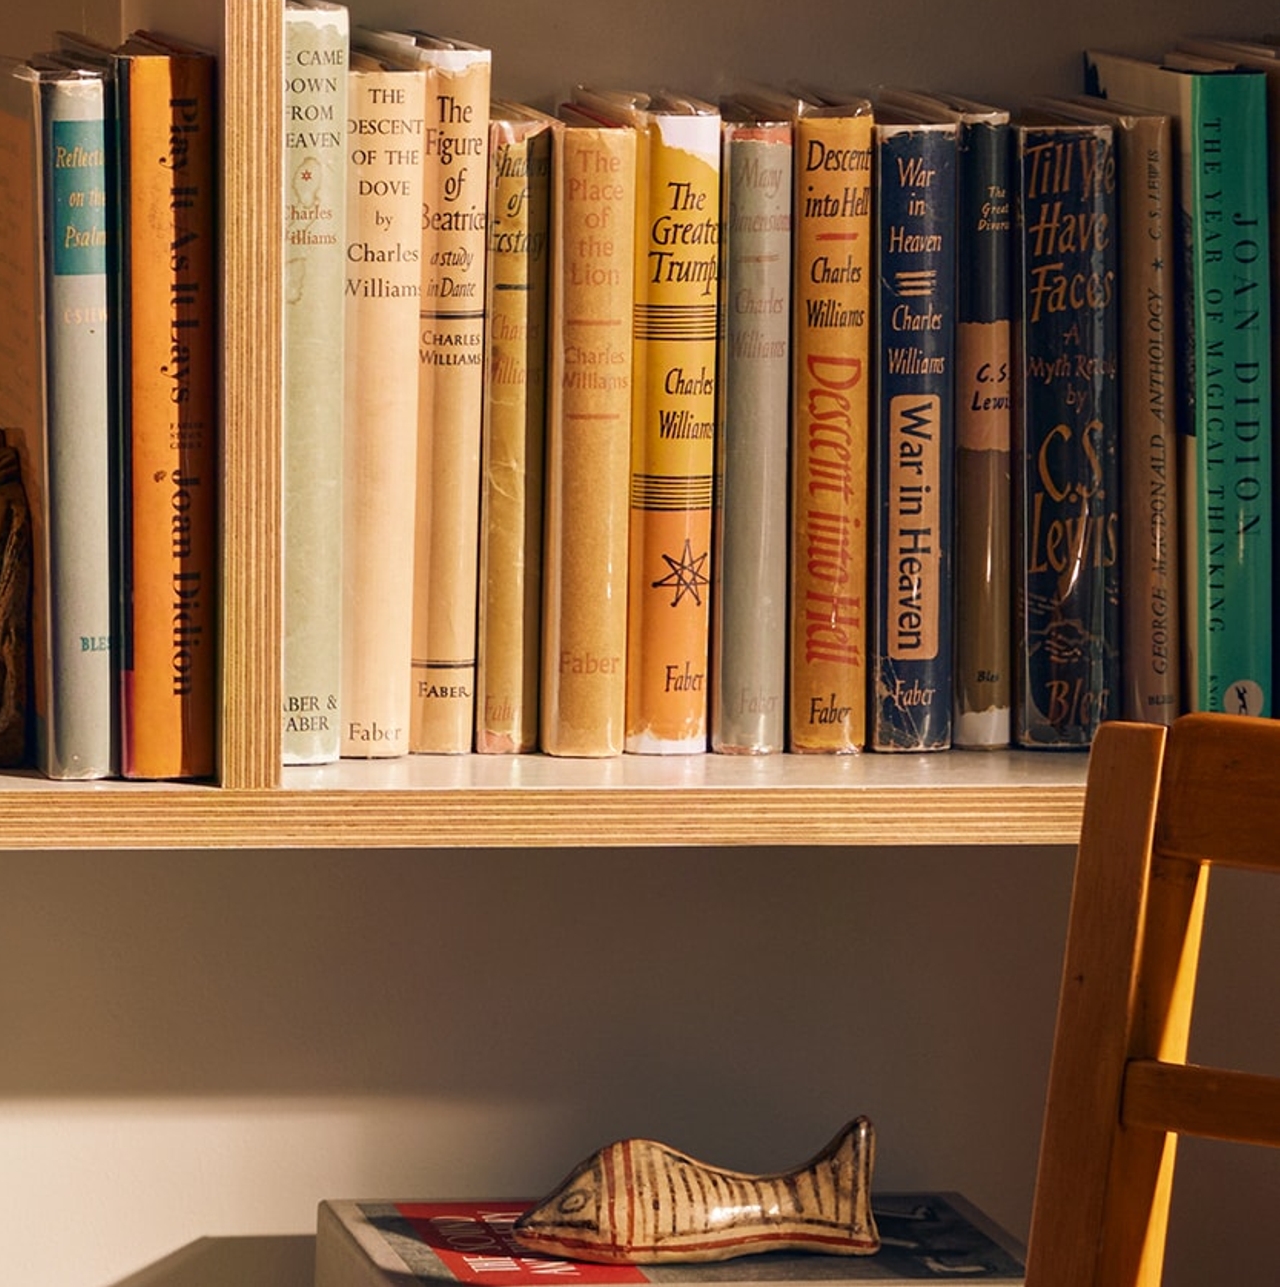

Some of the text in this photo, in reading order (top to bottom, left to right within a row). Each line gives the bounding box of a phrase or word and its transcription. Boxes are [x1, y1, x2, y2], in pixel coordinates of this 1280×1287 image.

[297, 50, 343, 66] CAME
[368, 88, 406, 105] THE
[437, 95, 473, 124] The
[159, 98, 199, 171] Play
[348, 119, 424, 134] DESCENT
[351, 149, 419, 165] OF THE
[425, 129, 483, 165] Figure
[806, 140, 871, 172] Descent
[577, 149, 620, 173] The
[898, 158, 935, 188] War
[1027, 139, 1073, 199] Till
[170, 187, 198, 208] It
[358, 181, 410, 197] DOVE
[444, 168, 467, 202] of
[568, 178, 624, 202] Place
[668, 182, 706, 211] The
[805, 186, 868, 219] into Hell
[909, 193, 926, 216] in
[982, 203, 1010, 216] Great
[375, 210, 393, 231] by
[421, 204, 485, 231] Beatrice
[1029, 202, 1110, 256] Have
[170, 223, 198, 272] As
[347, 243, 419, 263] Charles
[578, 236, 614, 256] the
[890, 228, 941, 253] Heaven
[440, 248, 474, 272] study
[811, 256, 861, 284] Charles
[571, 262, 620, 286] Lion
[170, 283, 199, 306] It
[345, 279, 421, 298] Williams
[440, 278, 477, 298] Dante
[1030, 263, 1115, 322] Faces
[806, 299, 864, 328] Williams
[892, 305, 942, 331] Charles
[421, 331, 481, 347] CHARLES
[160, 319, 200, 405] Lays
[420, 349, 482, 366] WILLIAMS
[564, 343, 625, 365] Charles
[889, 348, 944, 375] Williams
[1147, 288, 1165, 423] ANTHOLOGY
[563, 368, 628, 389] Williams
[665, 368, 714, 395] Charles
[1028, 355, 1071, 385] Myth
[1203, 118, 1225, 632] THE YEAR OF MAGICAL THINKING
[1234, 214, 1261, 536] JOAN DIDION
[1065, 382, 1088, 414] by
[659, 410, 715, 439] Williams
[171, 469, 202, 560] Joan
[806, 354, 863, 666] Descent into Hell
[898, 402, 933, 650] War in Heaven
[1029, 492, 1118, 573] Lewis
[171, 572, 203, 697] Didion
[1151, 587, 1168, 676] GEORGE
[559, 652, 620, 675] Faber
[418, 681, 472, 699] FABER
[665, 662, 704, 693] Faber
[894, 680, 935, 710] Faber
[809, 694, 852, 725] Faber
[348, 722, 402, 742] Faber
